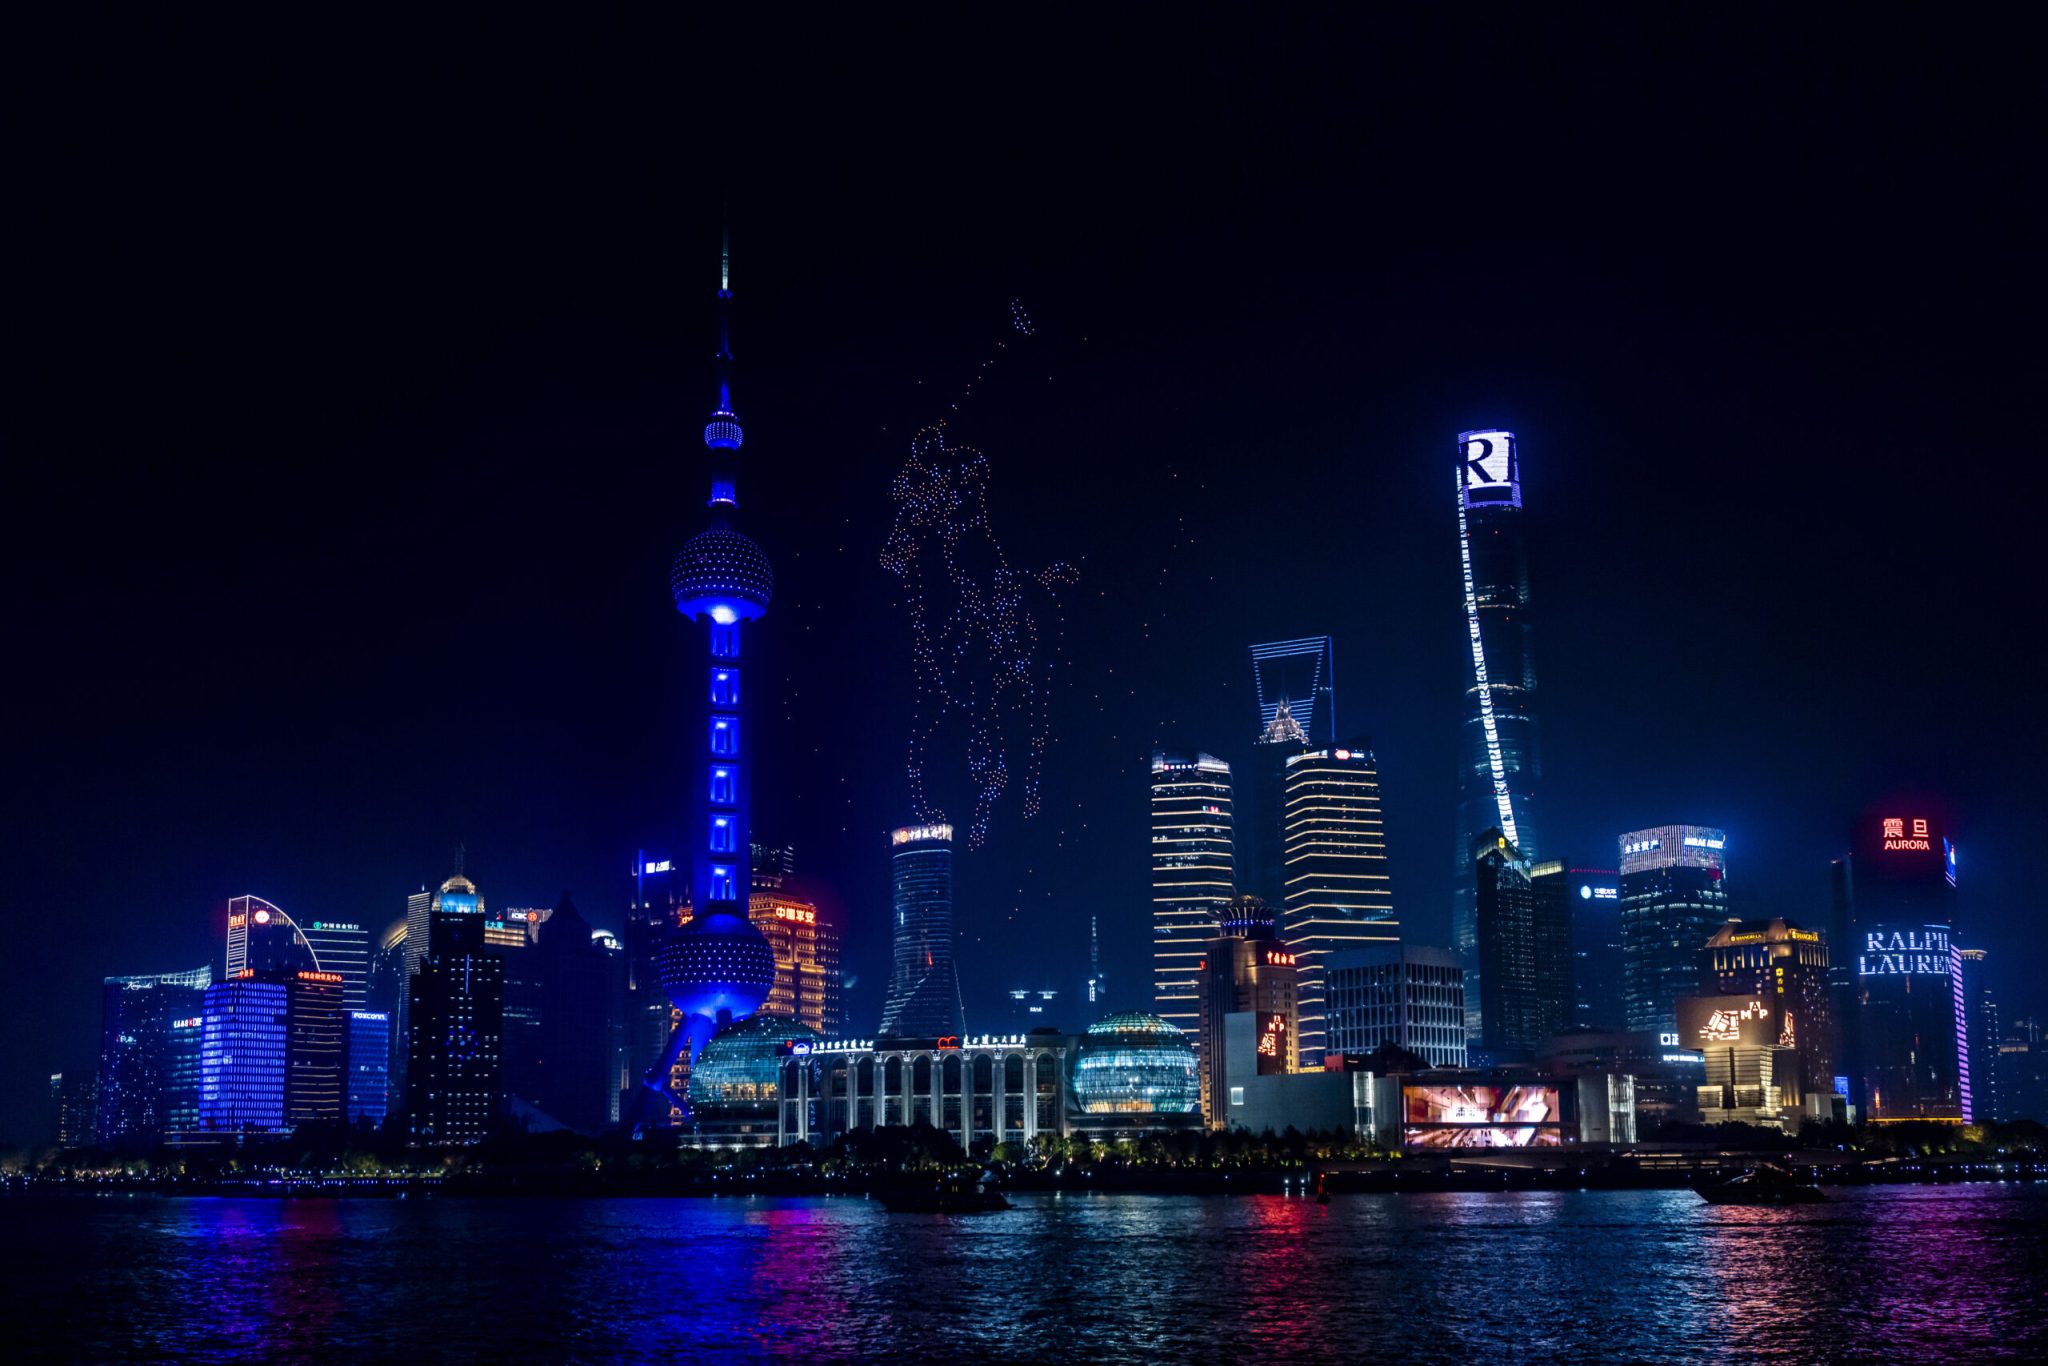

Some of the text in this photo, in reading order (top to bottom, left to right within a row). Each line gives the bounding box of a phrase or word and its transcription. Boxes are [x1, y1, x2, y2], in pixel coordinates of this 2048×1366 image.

[1883, 818, 1929, 838] 震旦
[1884, 839, 1930, 850] AURORA
[776, 907, 815, 924] 中国平安
[1866, 932, 1949, 951] RALPH
[1858, 954, 1952, 974] LAUREN
[1740, 1001, 1768, 1020] MAP
